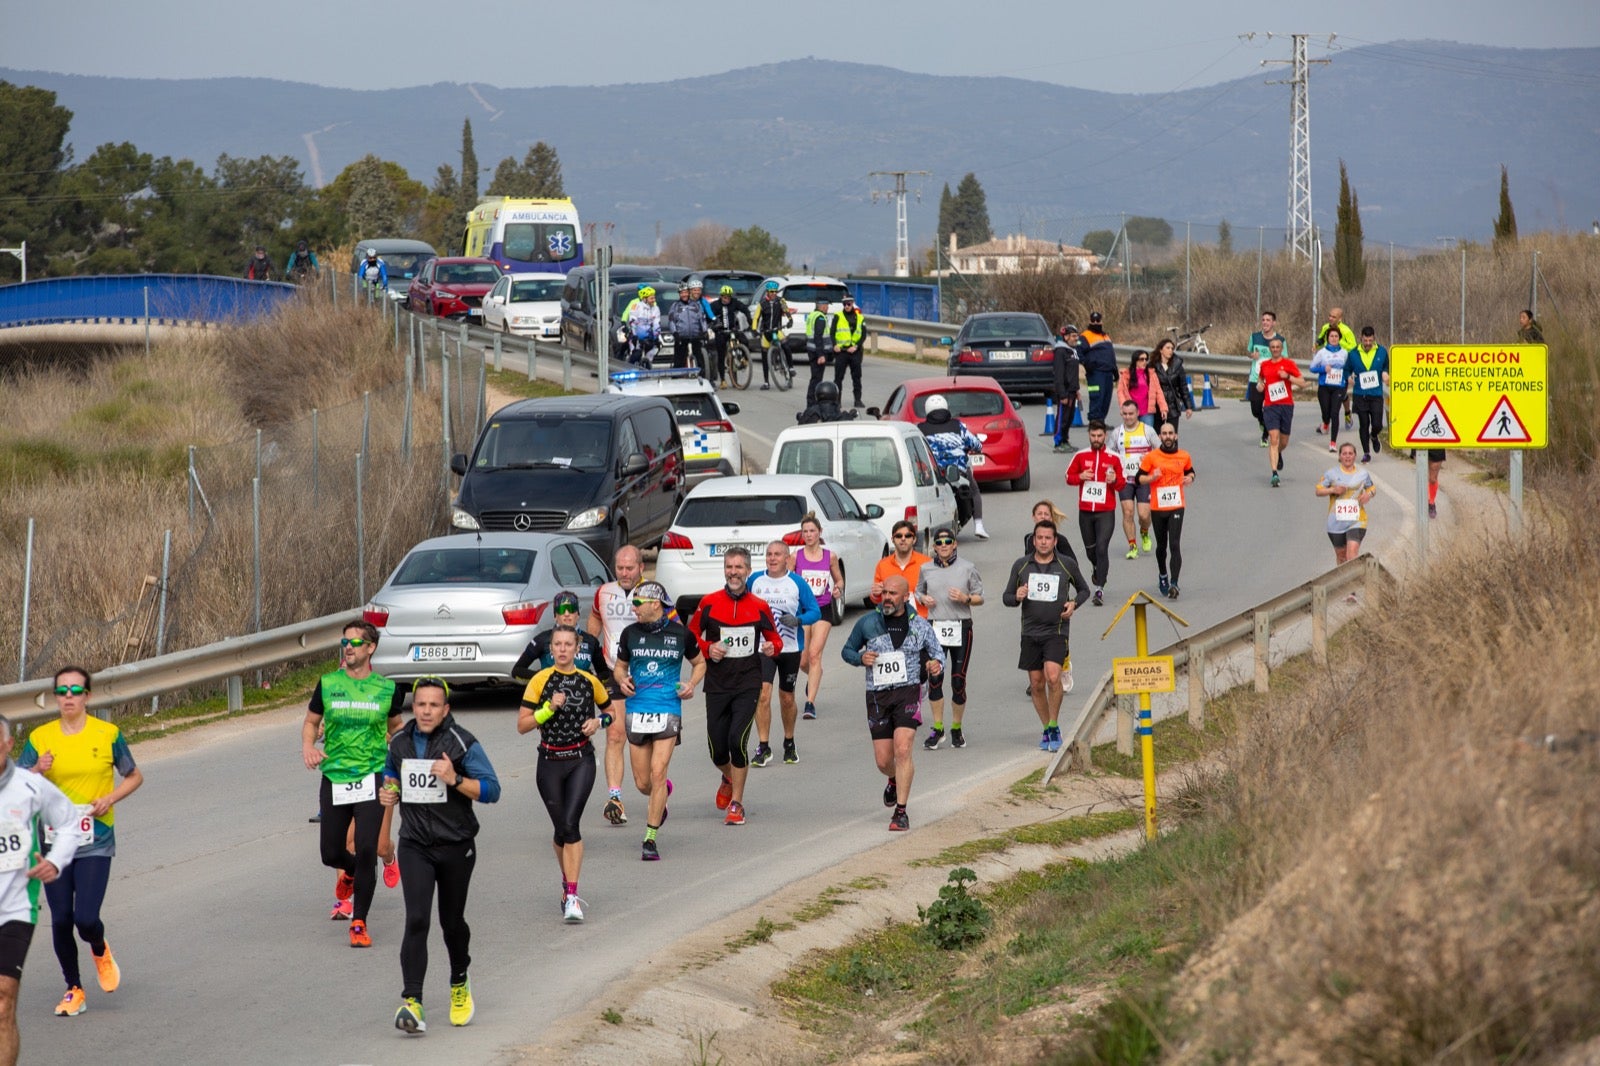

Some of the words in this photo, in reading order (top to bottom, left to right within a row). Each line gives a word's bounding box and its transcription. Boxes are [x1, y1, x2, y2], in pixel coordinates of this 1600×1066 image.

[512, 213, 567, 221] AMBULANCIA
[1416, 349, 1520, 364] PRECAUCIÓN
[1411, 367, 1440, 378] ZONA
[1445, 367, 1524, 378] FRECUENTADA
[1393, 381, 1414, 392] POR
[1418, 381, 1472, 392] CICLISTAS
[1476, 381, 1483, 391] Y
[1488, 381, 1543, 392] PEATONES
[675, 409, 702, 417] OCAL
[1086, 487, 1103, 496] 438
[1161, 492, 1177, 501] 437
[1337, 505, 1358, 514] 2126
[1037, 582, 1050, 592] 59
[941, 627, 954, 637] 52
[727, 636, 749, 647] 816
[421, 647, 448, 657] 5868
[452, 646, 472, 657] JTP
[631, 648, 679, 659] TRIATARFE
[877, 661, 900, 674] 780
[1124, 666, 1162, 676] ENAGAS
[639, 712, 661, 723] 721
[409, 772, 438, 788] 802
